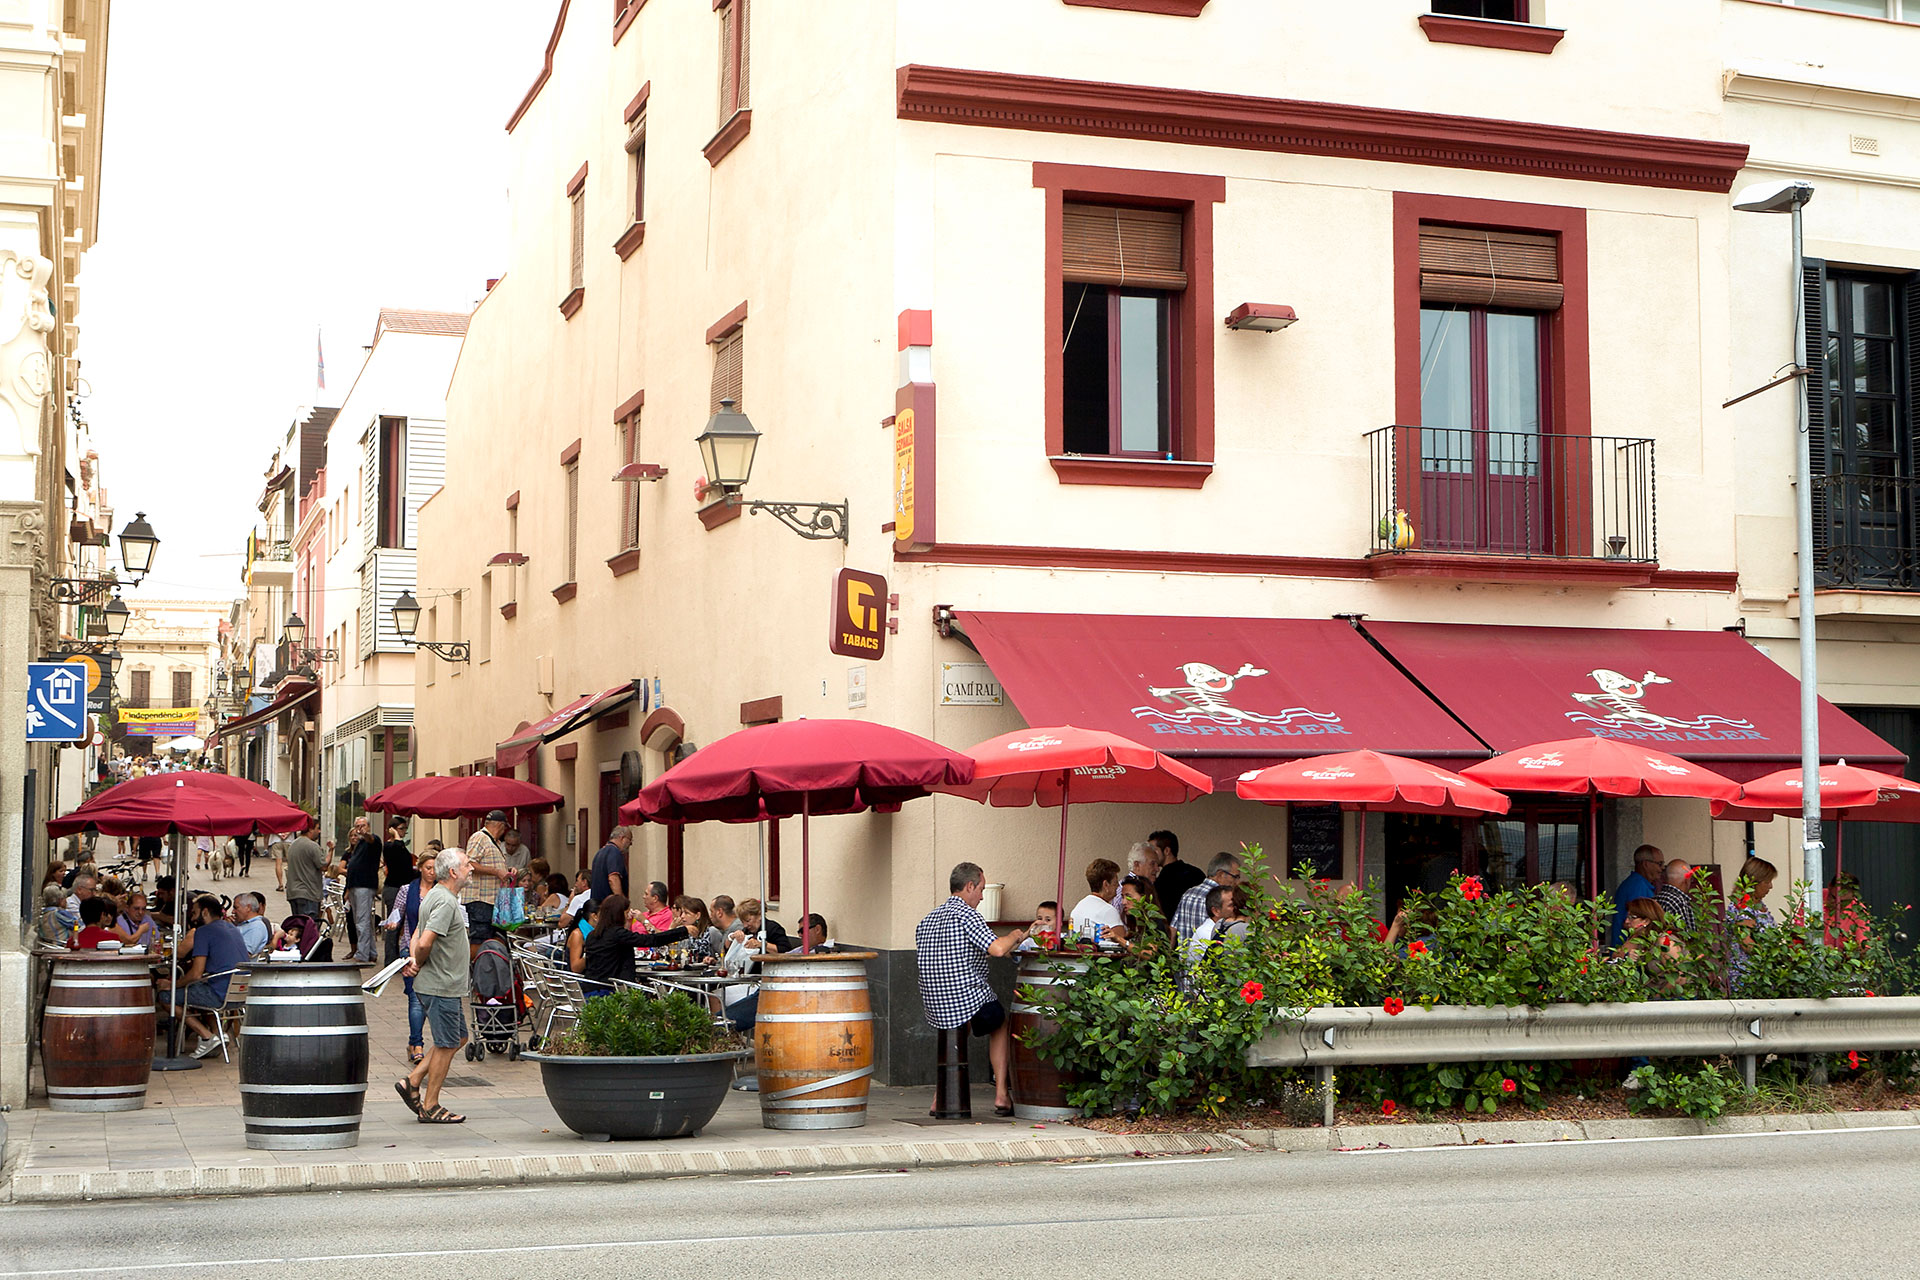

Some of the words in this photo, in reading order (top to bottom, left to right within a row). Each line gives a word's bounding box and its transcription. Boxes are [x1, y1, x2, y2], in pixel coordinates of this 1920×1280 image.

[842, 633, 879, 650] TABACS
[946, 681, 974, 696] CAMÍ
[975, 683, 998, 696] RAL
[1148, 723, 1353, 737] ESPINALER
[1586, 727, 1770, 741] ESPINALER
